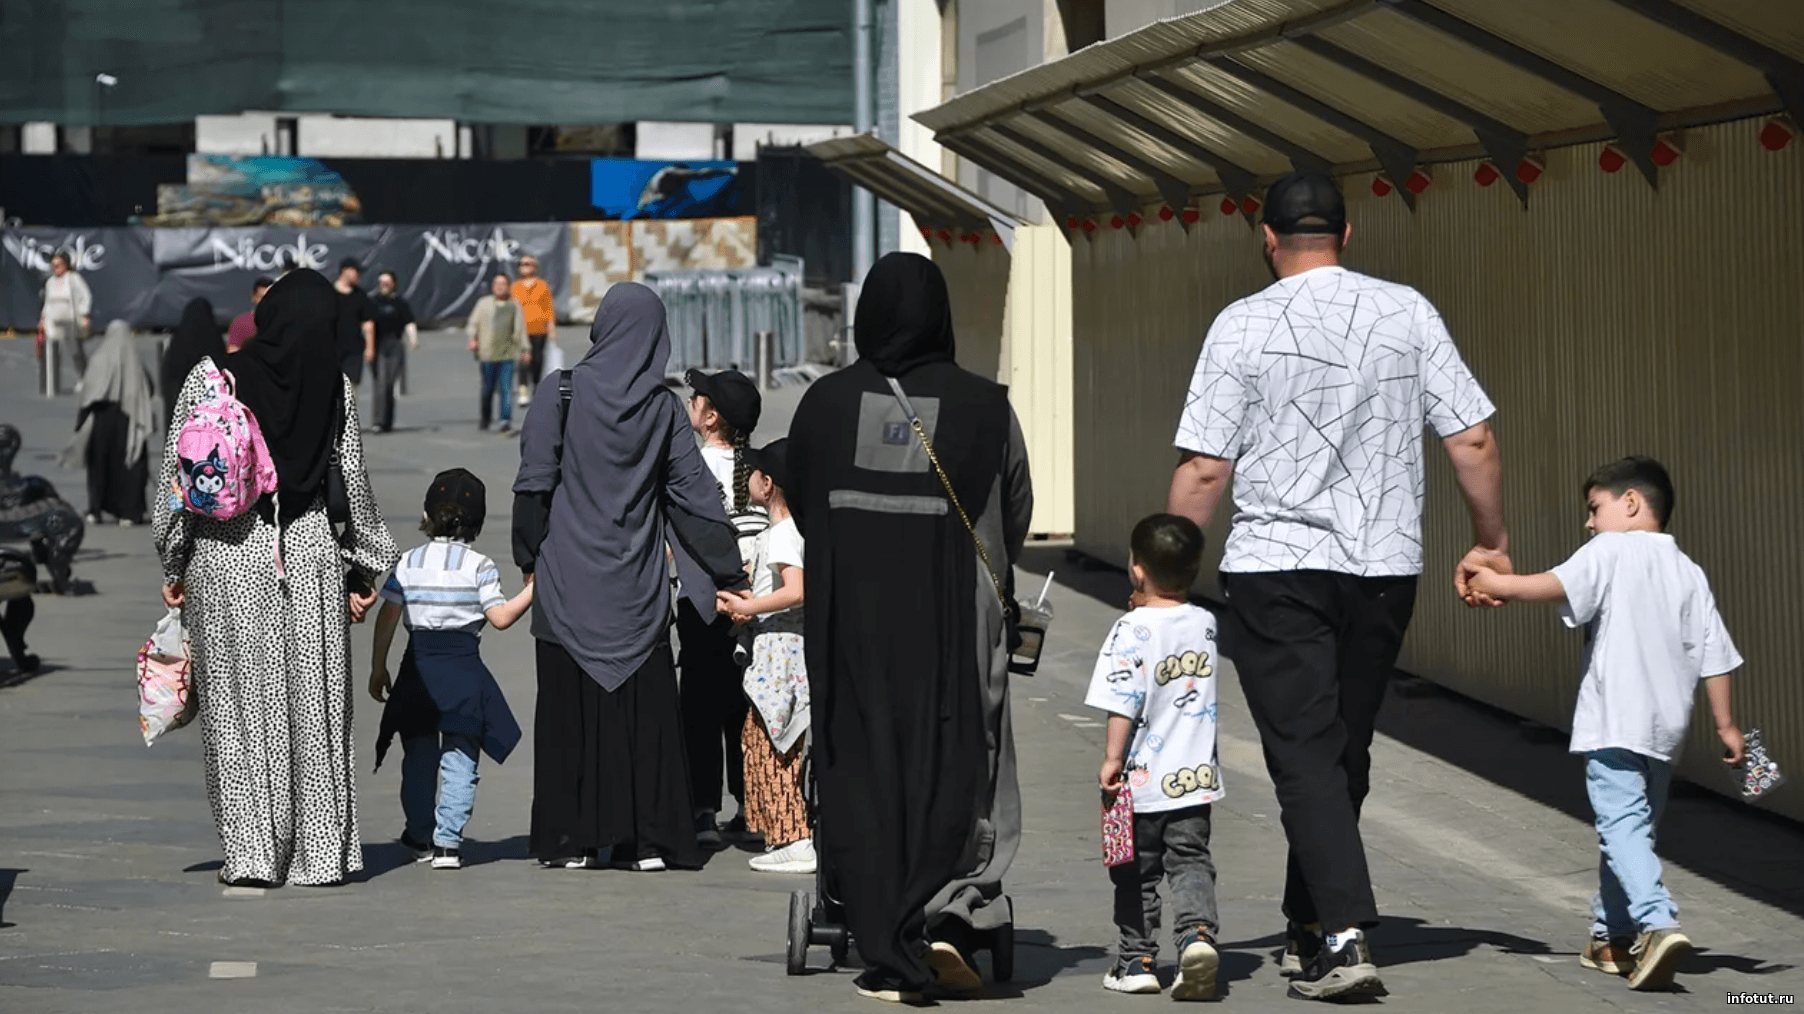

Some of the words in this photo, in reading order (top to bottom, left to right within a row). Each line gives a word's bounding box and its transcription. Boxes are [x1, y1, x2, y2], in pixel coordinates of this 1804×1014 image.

[213, 232, 329, 270] Nicole
[423, 227, 520, 264] Nicole
[1154, 650, 1213, 687] COOL
